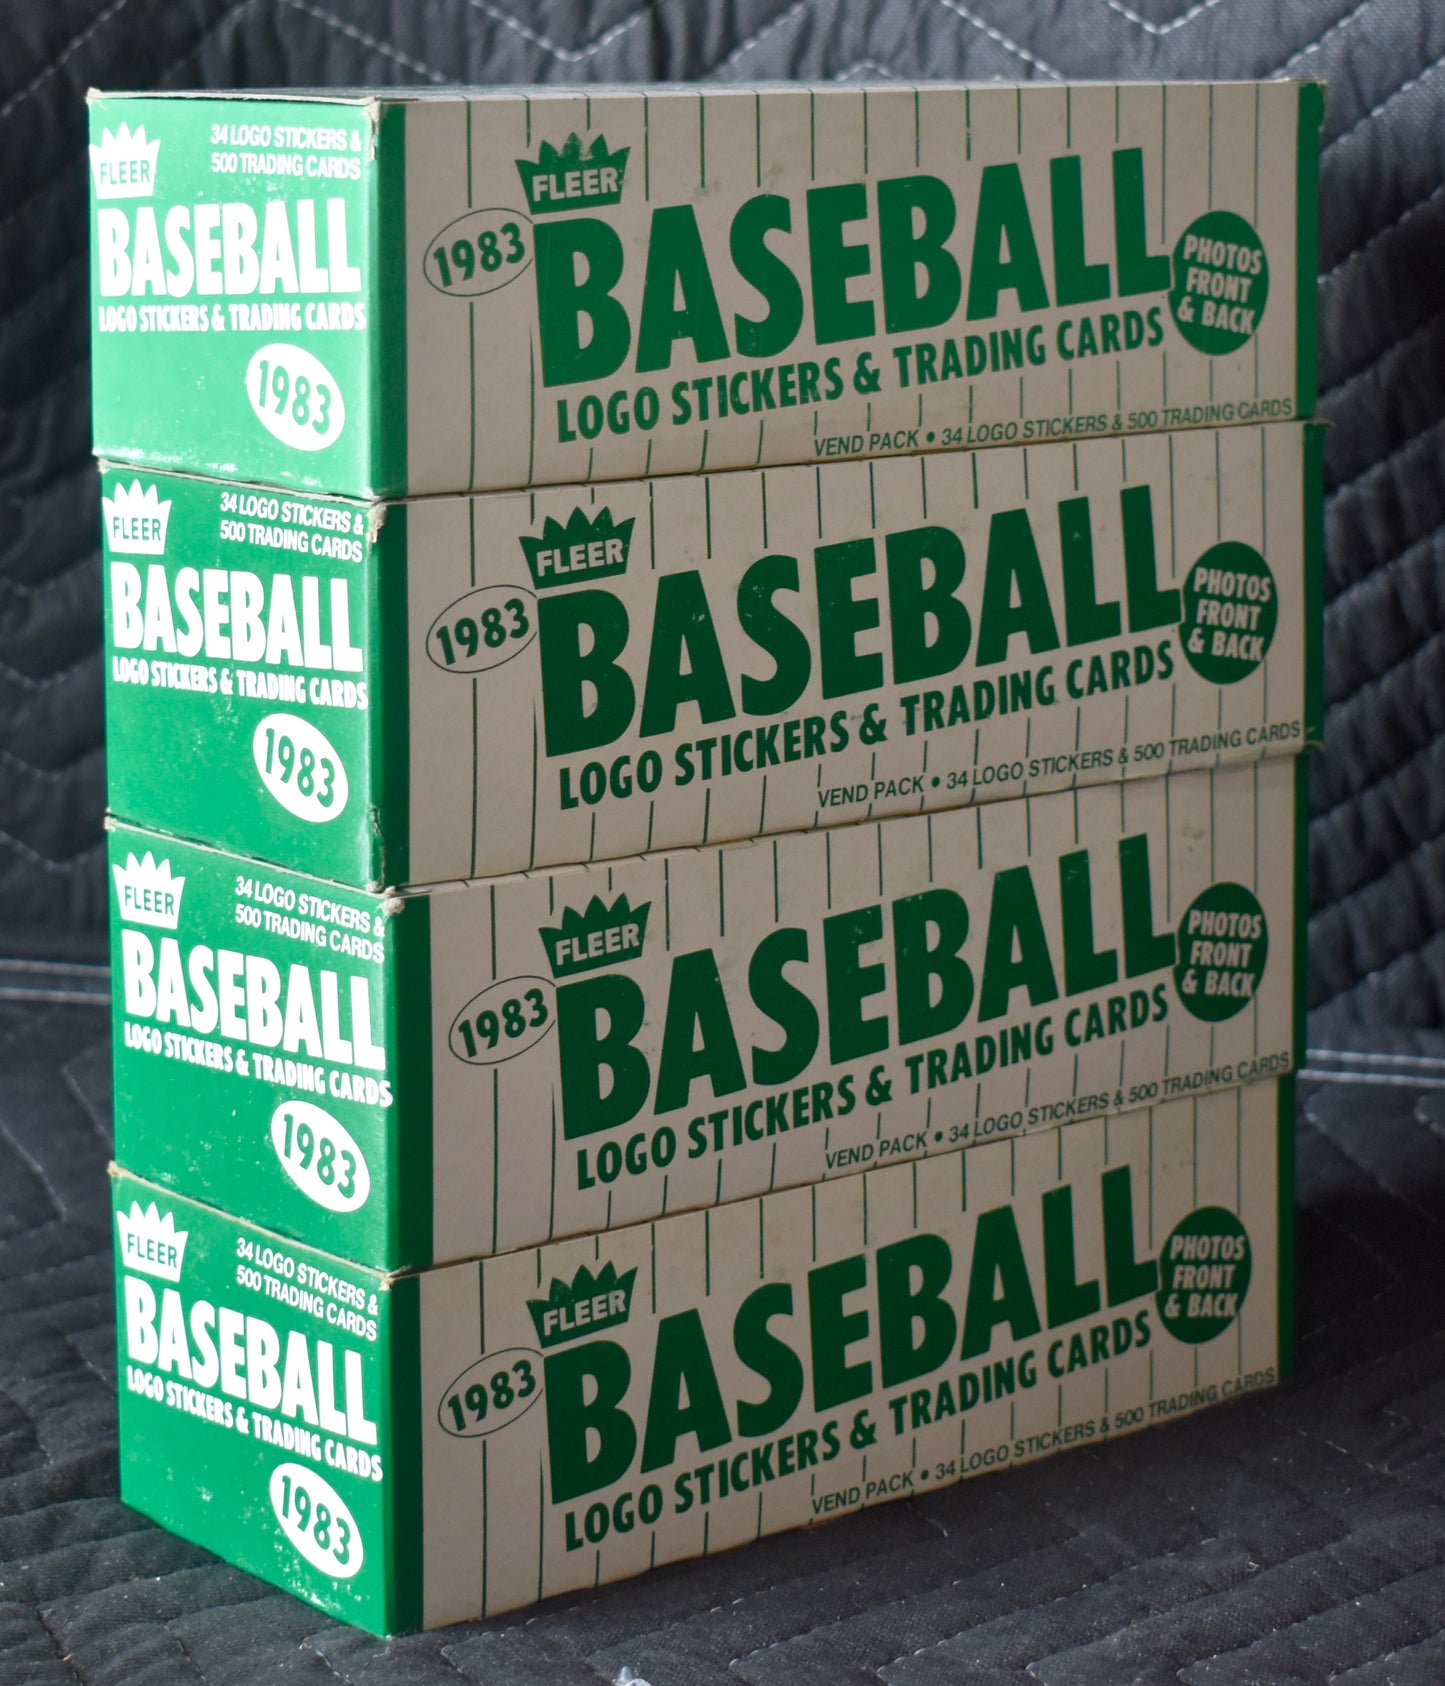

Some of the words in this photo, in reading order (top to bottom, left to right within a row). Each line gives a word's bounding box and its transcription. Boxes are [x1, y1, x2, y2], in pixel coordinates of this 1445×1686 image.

[211, 123, 232, 145] 34
[231, 125, 272, 147] LOGO
[274, 126, 347, 150] STICKERS
[351, 131, 361, 150] &
[211, 152, 238, 173] 500
[240, 153, 303, 176] TRADING
[306, 155, 361, 180] CARDS
[100, 159, 150, 185] FLEER
[531, 166, 619, 202] FLEER
[98, 198, 362, 297] BASEBALL
[433, 222, 525, 288] 1983
[533, 147, 1171, 388] BASEBALL
[1183, 233, 1262, 276] PHOTOS
[1177, 295, 1194, 323] &
[1201, 300, 1255, 335] BACK
[1186, 266, 1253, 304] FRONT
[99, 305, 137, 332] LOGO
[140, 304, 209, 332] STICKERS
[212, 304, 225, 332] &
[229, 303, 302, 331] TRADING
[305, 302, 366, 331] CARDS
[259, 360, 331, 435] 1983
[557, 385, 660, 444] LOGO
[671, 357, 844, 426] STICKERS
[853, 351, 882, 395] &
[893, 325, 1046, 388] TRADING
[1056, 307, 1164, 361] CARDS
[814, 434, 864, 457] VEND
[869, 429, 919, 451] PACK
[941, 427, 963, 446] 34
[966, 422, 1018, 444] LOGO
[1023, 413, 1108, 439] STICKERS
[1112, 411, 1123, 431] &
[1128, 411, 1158, 429] 500
[1162, 403, 1235, 426] TRADING
[1238, 397, 1292, 420] CARDS
[113, 516, 161, 542] FLEER
[220, 491, 238, 512] 34
[239, 496, 278, 520] LOGO
[281, 502, 351, 533] STICKERS
[353, 514, 364, 535] &
[220, 520, 246, 541] 500
[247, 524, 308, 553] TRADING
[311, 534, 363, 563] CARDS
[536, 538, 625, 578] FLEER
[1193, 567, 1272, 602] PHOTOS
[110, 561, 363, 672] BASEBALL
[436, 597, 530, 666] 1983
[537, 484, 1182, 758] BASEBALL
[1187, 628, 1204, 654] &
[1211, 631, 1264, 662] BACK
[1196, 598, 1262, 631] FRONT
[113, 656, 149, 685] LOGO
[151, 661, 218, 694] STICKERS
[220, 668, 233, 695] &
[236, 670, 306, 703] TRADING
[309, 677, 368, 710] CARDS
[560, 750, 663, 811] LOGO
[675, 710, 849, 786] STICKERS
[858, 703, 888, 745] &
[900, 665, 1055, 736] TRADING
[1066, 640, 1174, 700] CARDS
[265, 727, 335, 807] 1983
[818, 784, 868, 808] VEND
[874, 775, 924, 799] PACK
[946, 770, 968, 790] 34
[972, 762, 1024, 786] LOGO
[1028, 749, 1113, 777] STICKERS
[1118, 746, 1129, 764] &
[1134, 742, 1164, 762] 500
[1169, 730, 1241, 755] TRADING
[1246, 721, 1300, 746] CARDS
[124, 885, 175, 916] FLEER
[235, 875, 252, 898] 34
[254, 881, 295, 908] LOGO
[298, 892, 371, 933] STICKERS
[373, 916, 385, 937] &
[1187, 909, 1262, 939] PHOTOS
[235, 903, 262, 928] 500
[264, 910, 326, 948] TRADING
[329, 929, 385, 964] CARDS
[555, 923, 640, 966] FLEER
[1190, 940, 1253, 968] FRONT
[122, 928, 386, 1070] BASEBALL
[556, 833, 1177, 1141] BASEBALL
[1181, 968, 1198, 995] &
[1204, 970, 1256, 998] BACK
[458, 988, 549, 1059] 1983
[124, 1021, 162, 1056] LOGO
[164, 1032, 233, 1073] STICKERS
[235, 1048, 250, 1077] &
[252, 1052, 325, 1094] TRADING
[329, 1070, 393, 1108] CARDS
[577, 1126, 677, 1191] LOGO
[688, 1075, 856, 1159] STICKERS
[865, 1064, 892, 1106] &
[905, 1016, 1054, 1095] TRADING
[1064, 983, 1169, 1047] CARDS
[825, 1145, 874, 1170] VEND
[879, 1131, 927, 1158] PACK
[949, 1125, 970, 1143] 34
[973, 1111, 1023, 1139] LOGO
[1028, 1092, 1110, 1125] STICKERS
[1113, 1090, 1125, 1108] &
[1128, 1082, 1158, 1103] 500
[1162, 1064, 1233, 1095] TRADING
[1237, 1051, 1290, 1079] CARDS
[283, 1113, 356, 1199] 1983
[127, 1233, 177, 1269] FLEER
[236, 1237, 253, 1261] 34
[255, 1244, 295, 1279] LOGO
[297, 1263, 365, 1309] STICKERS
[367, 1293, 378, 1317] &
[1169, 1234, 1246, 1261] PHOTOS
[1172, 1264, 1236, 1290] FRONT
[236, 1264, 262, 1292] 500
[264, 1274, 324, 1318] TRADING
[326, 1303, 377, 1342] CARDS
[542, 1289, 626, 1337] FLEER
[1164, 1293, 1181, 1319] &
[1187, 1292, 1239, 1319] BACK
[124, 1275, 377, 1445] BASEBALL
[543, 1164, 1159, 1505] BASEBALL
[127, 1365, 163, 1402] LOGO
[166, 1380, 233, 1428] STICKERS
[235, 1406, 249, 1435] &
[252, 1411, 322, 1462] TRADING
[325, 1438, 383, 1482] CARDS
[447, 1359, 536, 1432] 1983
[565, 1483, 663, 1552] LOGO
[674, 1420, 840, 1514] STICKERS
[850, 1409, 877, 1449] &
[889, 1350, 1037, 1436] TRADING
[1047, 1309, 1151, 1379] CARDS
[812, 1486, 860, 1515] VEND
[866, 1470, 914, 1499] PACK
[935, 1461, 956, 1480] 34
[959, 1445, 1009, 1473] LOGO
[1014, 1421, 1096, 1459] STICKERS
[1099, 1416, 1110, 1433] &
[1115, 1406, 1144, 1429] 500
[1147, 1385, 1217, 1419] TRADING
[1221, 1367, 1275, 1397] CARDS
[281, 1475, 350, 1565] 1983
